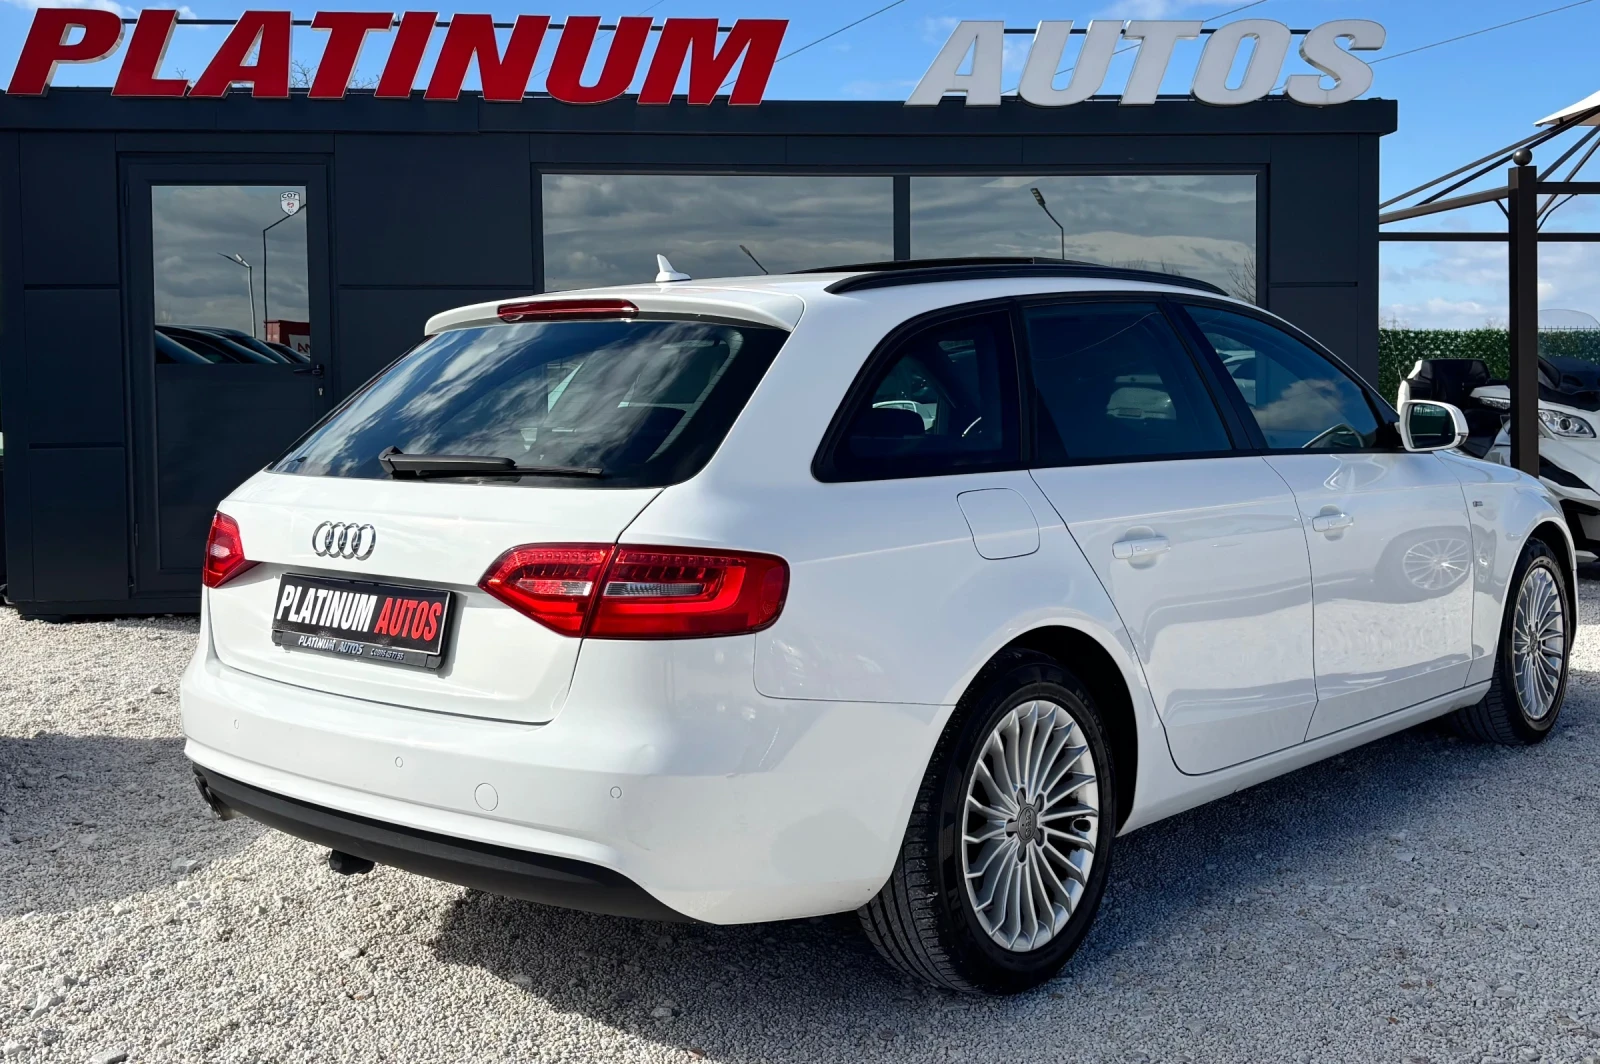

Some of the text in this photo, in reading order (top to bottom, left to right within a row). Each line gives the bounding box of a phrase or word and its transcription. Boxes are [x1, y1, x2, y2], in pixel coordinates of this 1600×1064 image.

[5, 8, 1386, 108] PLATINUM AUTOS
[276, 584, 442, 641] PLATINUM AUTOS
[298, 635, 364, 655] PLATINUM AUTOS
